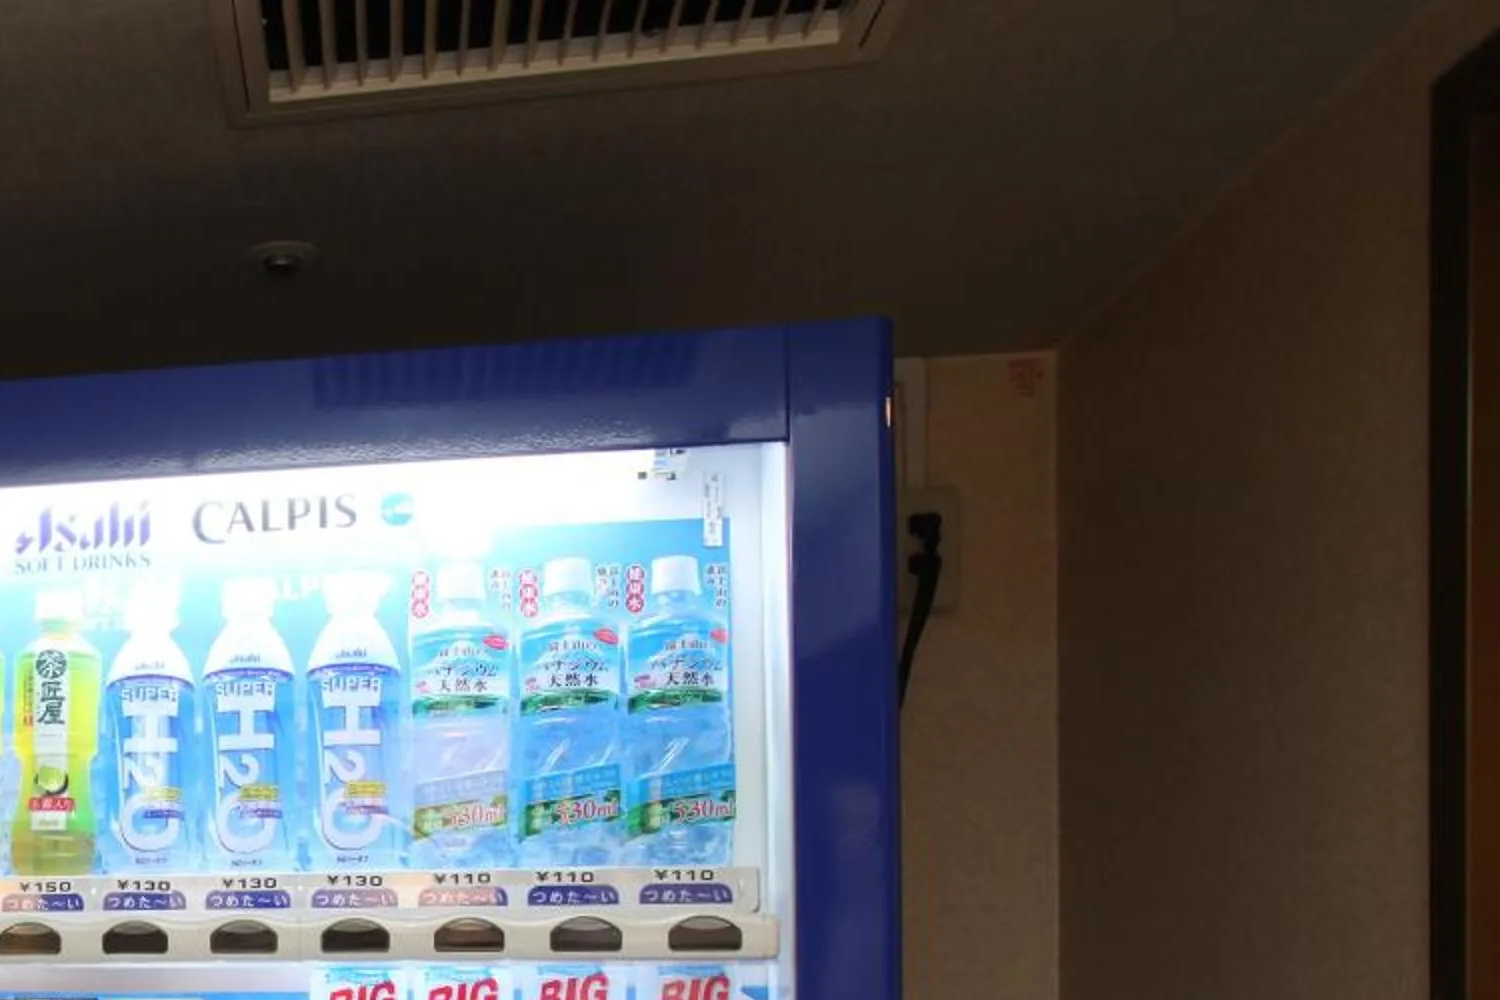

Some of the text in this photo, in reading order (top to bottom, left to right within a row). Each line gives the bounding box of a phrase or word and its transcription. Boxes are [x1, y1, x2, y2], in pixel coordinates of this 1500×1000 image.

[193, 494, 358, 545] CALPIS
[15, 501, 152, 554] Asahi
[15, 553, 152, 576] SOFT DRINKS
[322, 676, 383, 693] SUPER
[548, 673, 599, 687] 天然水
[666, 671, 714, 686] 天然水
[214, 681, 276, 697] SUPER
[440, 679, 488, 693] 天然水
[121, 687, 179, 702] SUPER
[327, 875, 383, 887] ¥130
[434, 872, 491, 885] ¥110
[536, 871, 594, 884] ¥110
[654, 869, 714, 882] ¥110
[19, 880, 71, 893] ¥150
[117, 879, 170, 892] ¥130
[223, 877, 277, 890] ¥130
